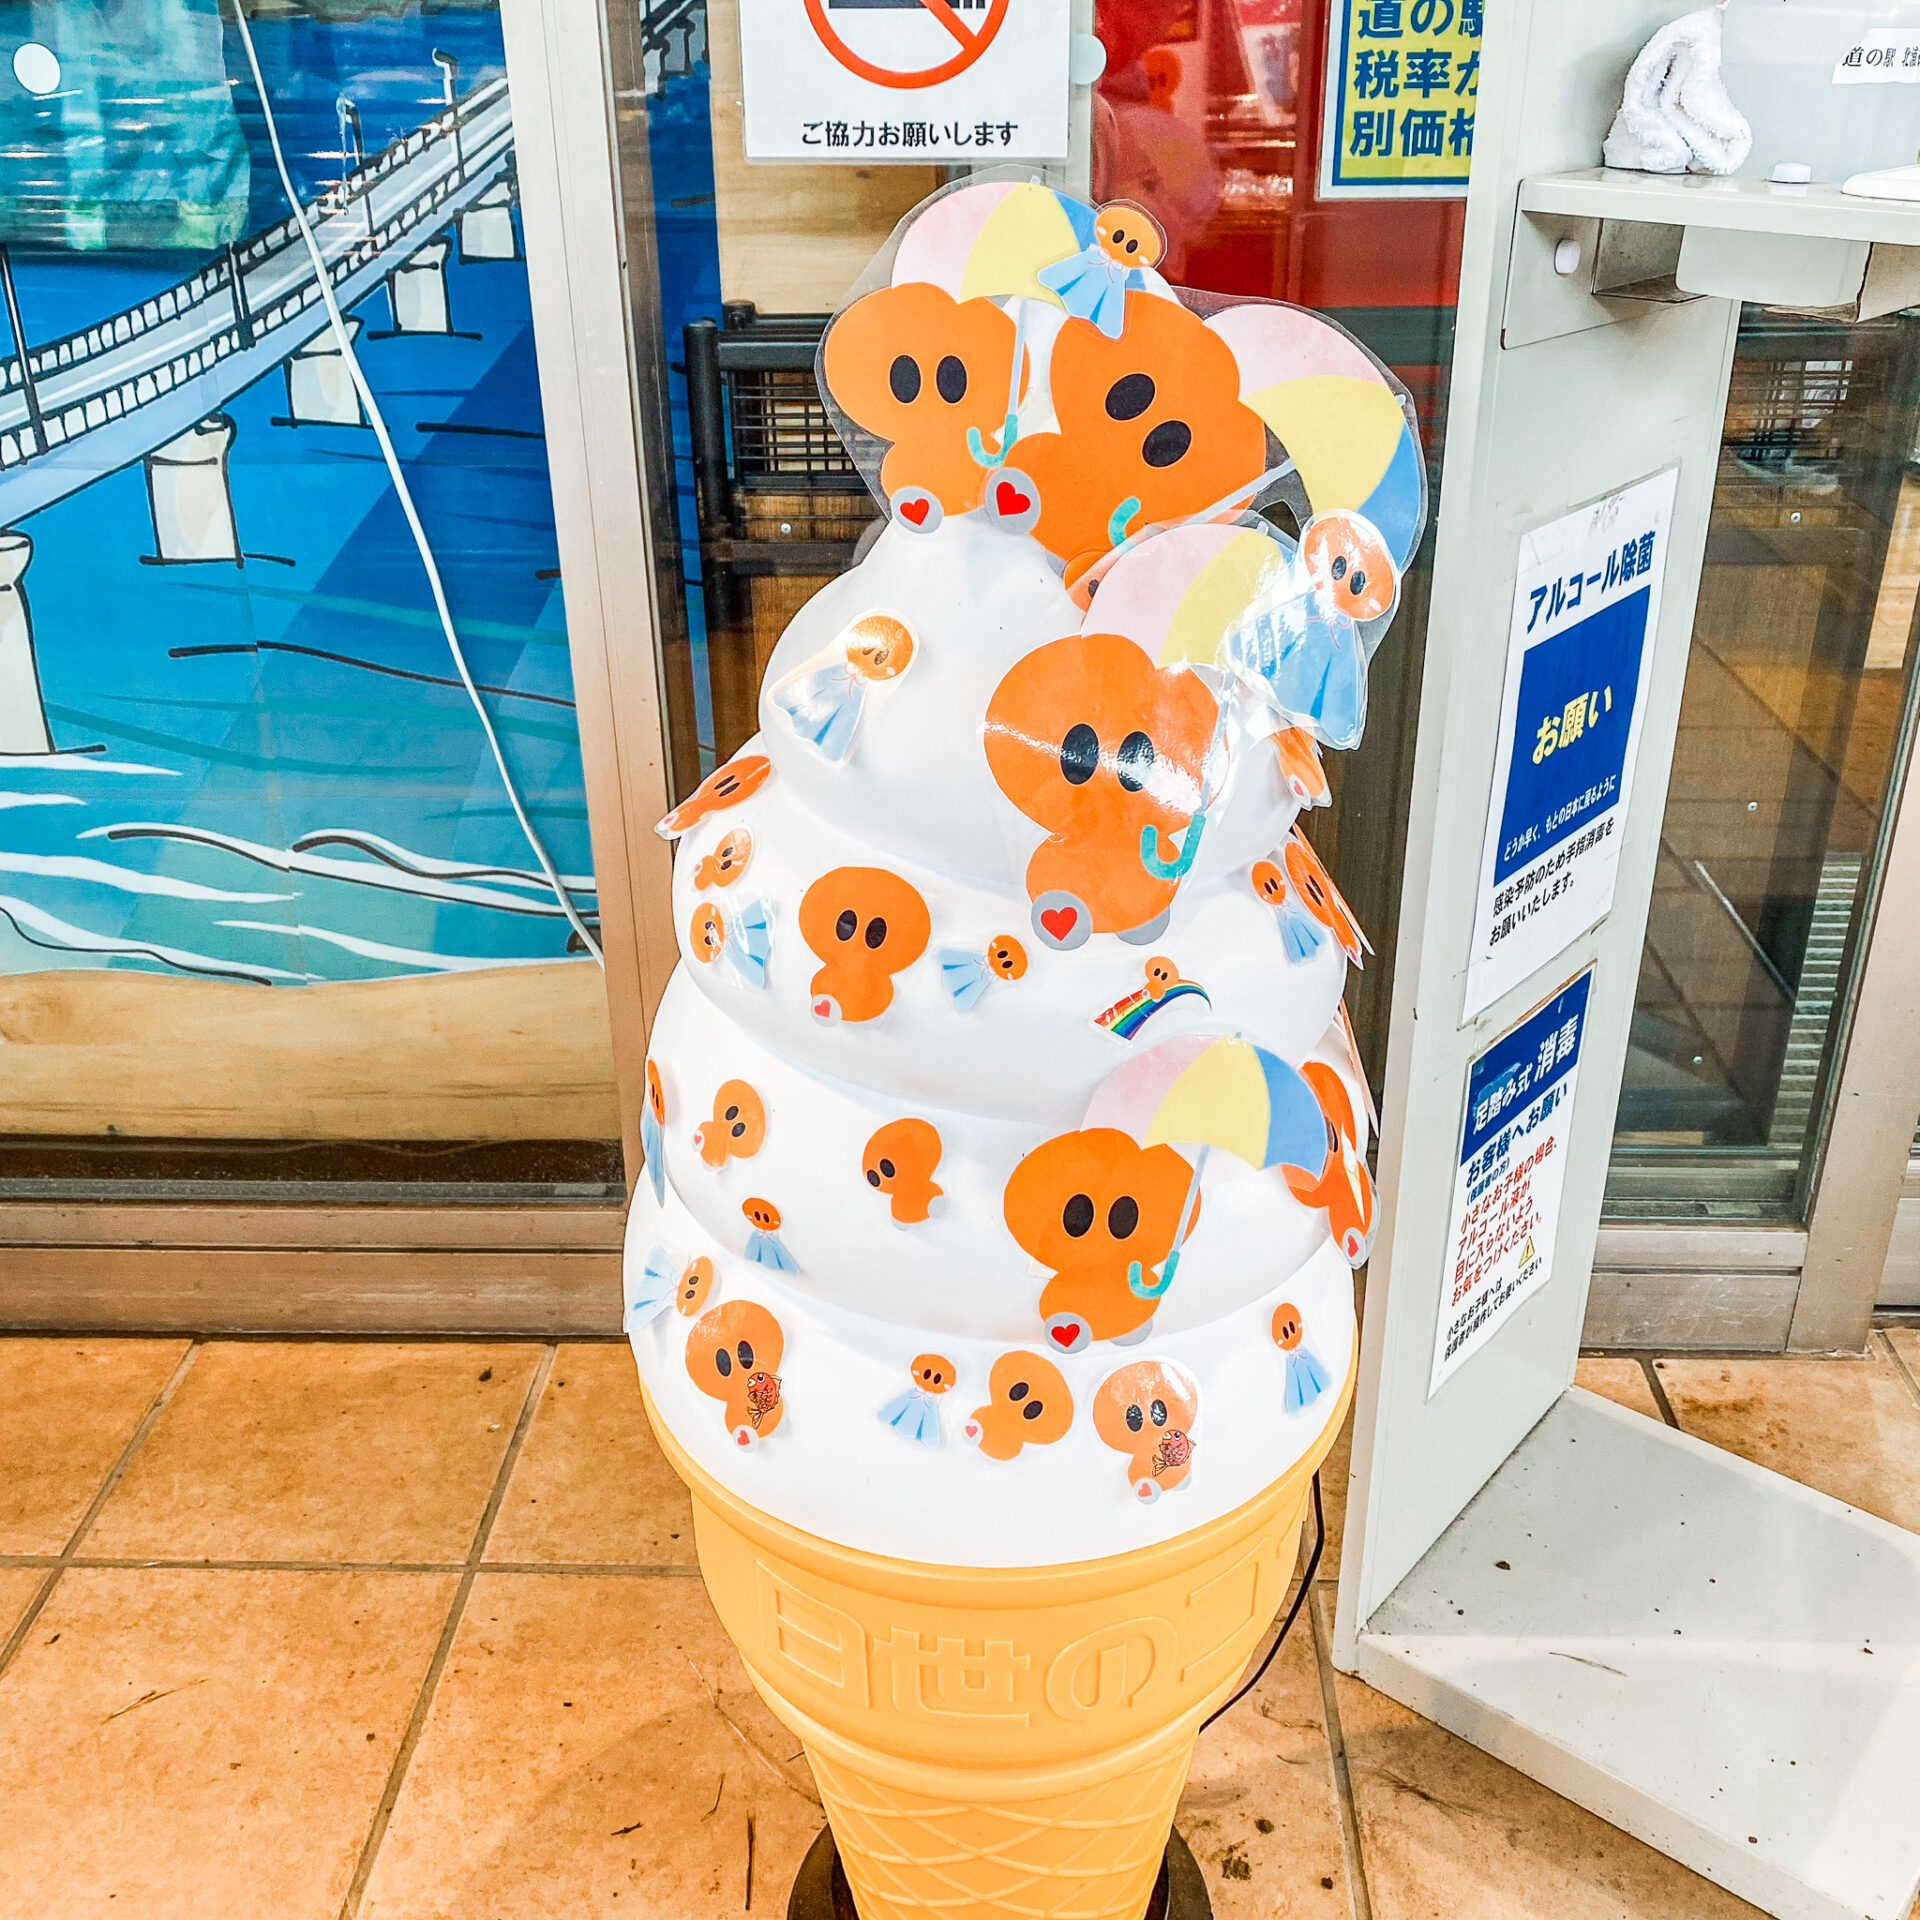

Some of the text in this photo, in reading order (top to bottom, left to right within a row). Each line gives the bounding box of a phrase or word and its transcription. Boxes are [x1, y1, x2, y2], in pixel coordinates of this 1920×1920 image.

[802, 121, 1019, 147] ご協力お願いします
[1527, 530, 1655, 634] アルコール除菌
[1532, 685, 1612, 765] お願い
[1489, 871, 1574, 946] お願いいたします。
[1493, 816, 1615, 917] 感染予防のため手指消毒を
[1466, 1082, 1567, 1188] お客様へお願い
[1454, 1196, 1533, 1285] 目に入らないよう
